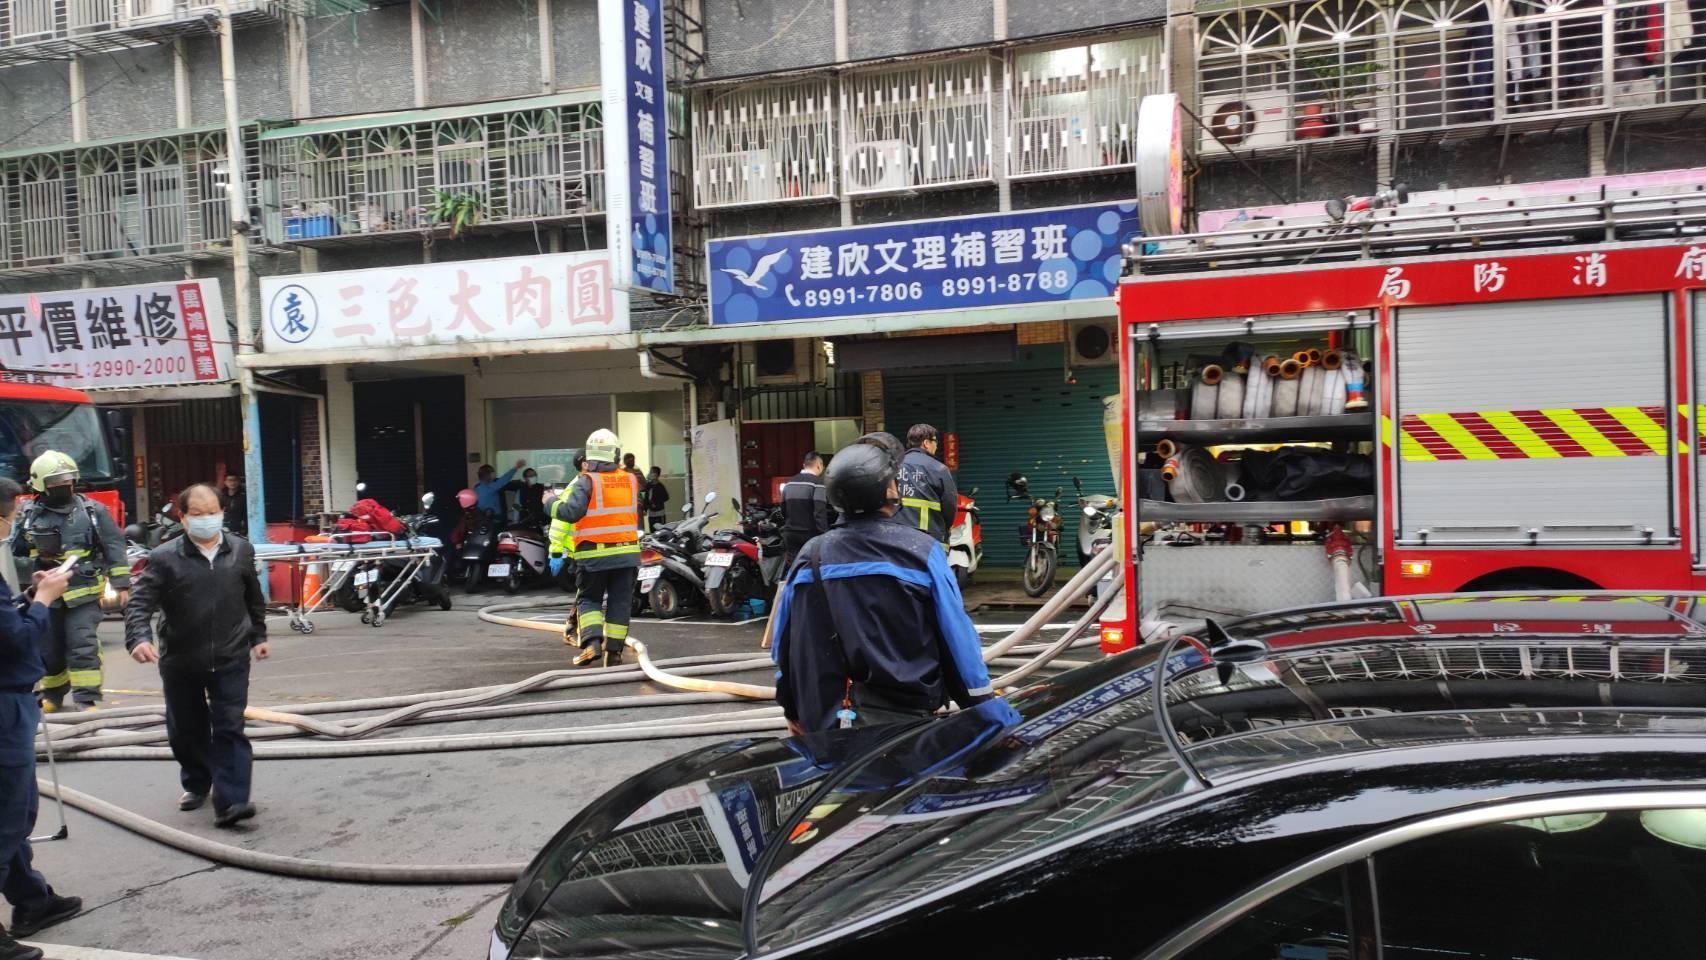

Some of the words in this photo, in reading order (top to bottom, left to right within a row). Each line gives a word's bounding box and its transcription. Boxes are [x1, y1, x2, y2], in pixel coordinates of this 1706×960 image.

[800, 224, 1068, 281] 建欣文理補習班
[281, 292, 310, 335] 袁
[333, 259, 613, 337] 三色大肉圓
[804, 281, 923, 308] 8991-7806
[941, 269, 1069, 297] 8991-8788
[0, 291, 178, 356] 平價維修
